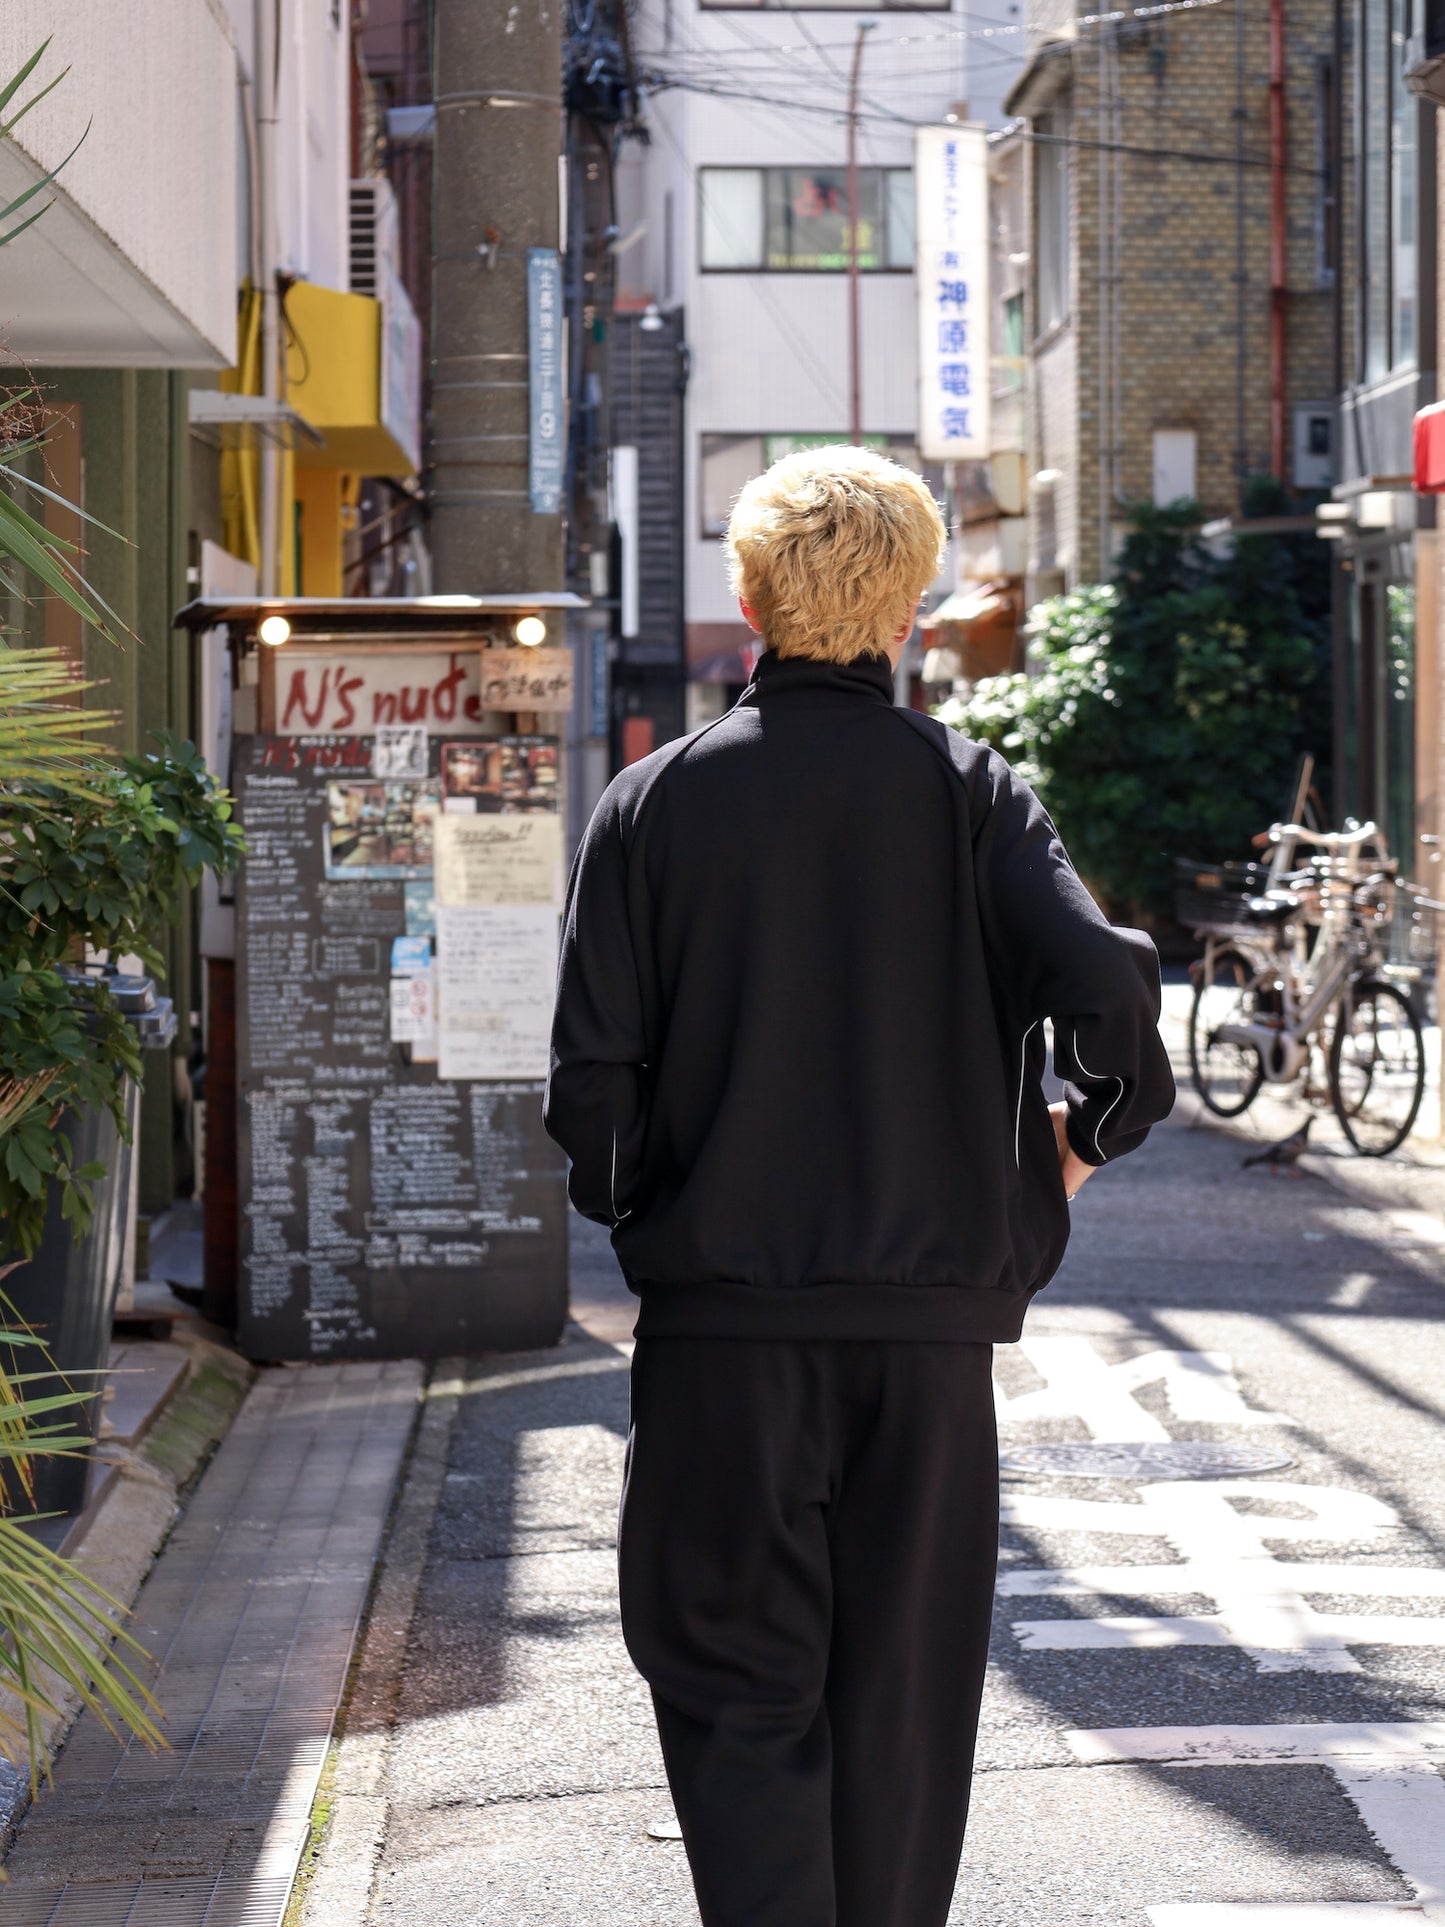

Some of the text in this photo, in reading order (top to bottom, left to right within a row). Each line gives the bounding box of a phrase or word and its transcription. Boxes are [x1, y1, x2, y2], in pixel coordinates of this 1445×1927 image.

[937, 279, 972, 439] 神原電気
[539, 411, 555, 438] 9
[282, 654, 483, 730] N's nude
